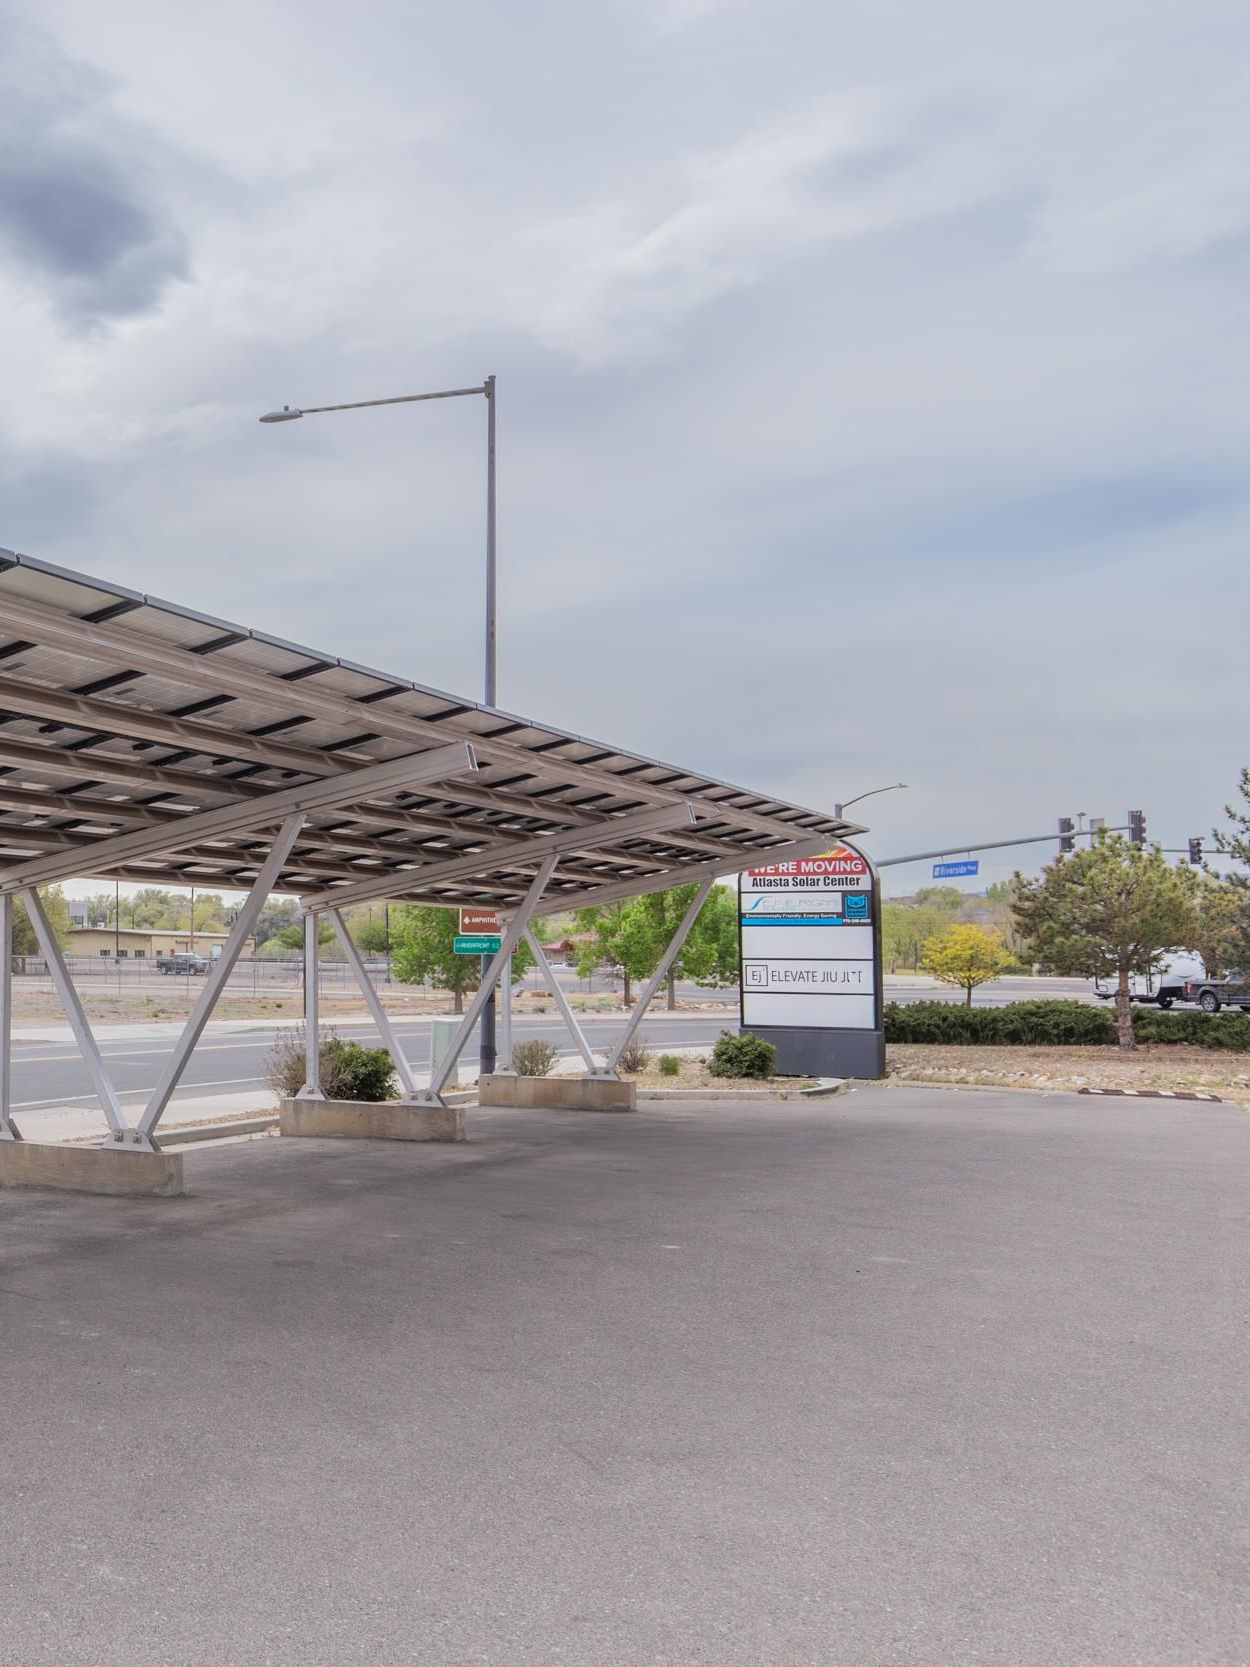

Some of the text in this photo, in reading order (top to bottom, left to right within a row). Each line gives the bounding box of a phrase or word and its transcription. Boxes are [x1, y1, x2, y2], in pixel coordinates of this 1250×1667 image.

[801, 860, 862, 872] MOVING
[752, 875, 860, 888] Atlasta Solar Center
[771, 970, 818, 983] ELEVATE
[821, 970, 838, 983] JIU
